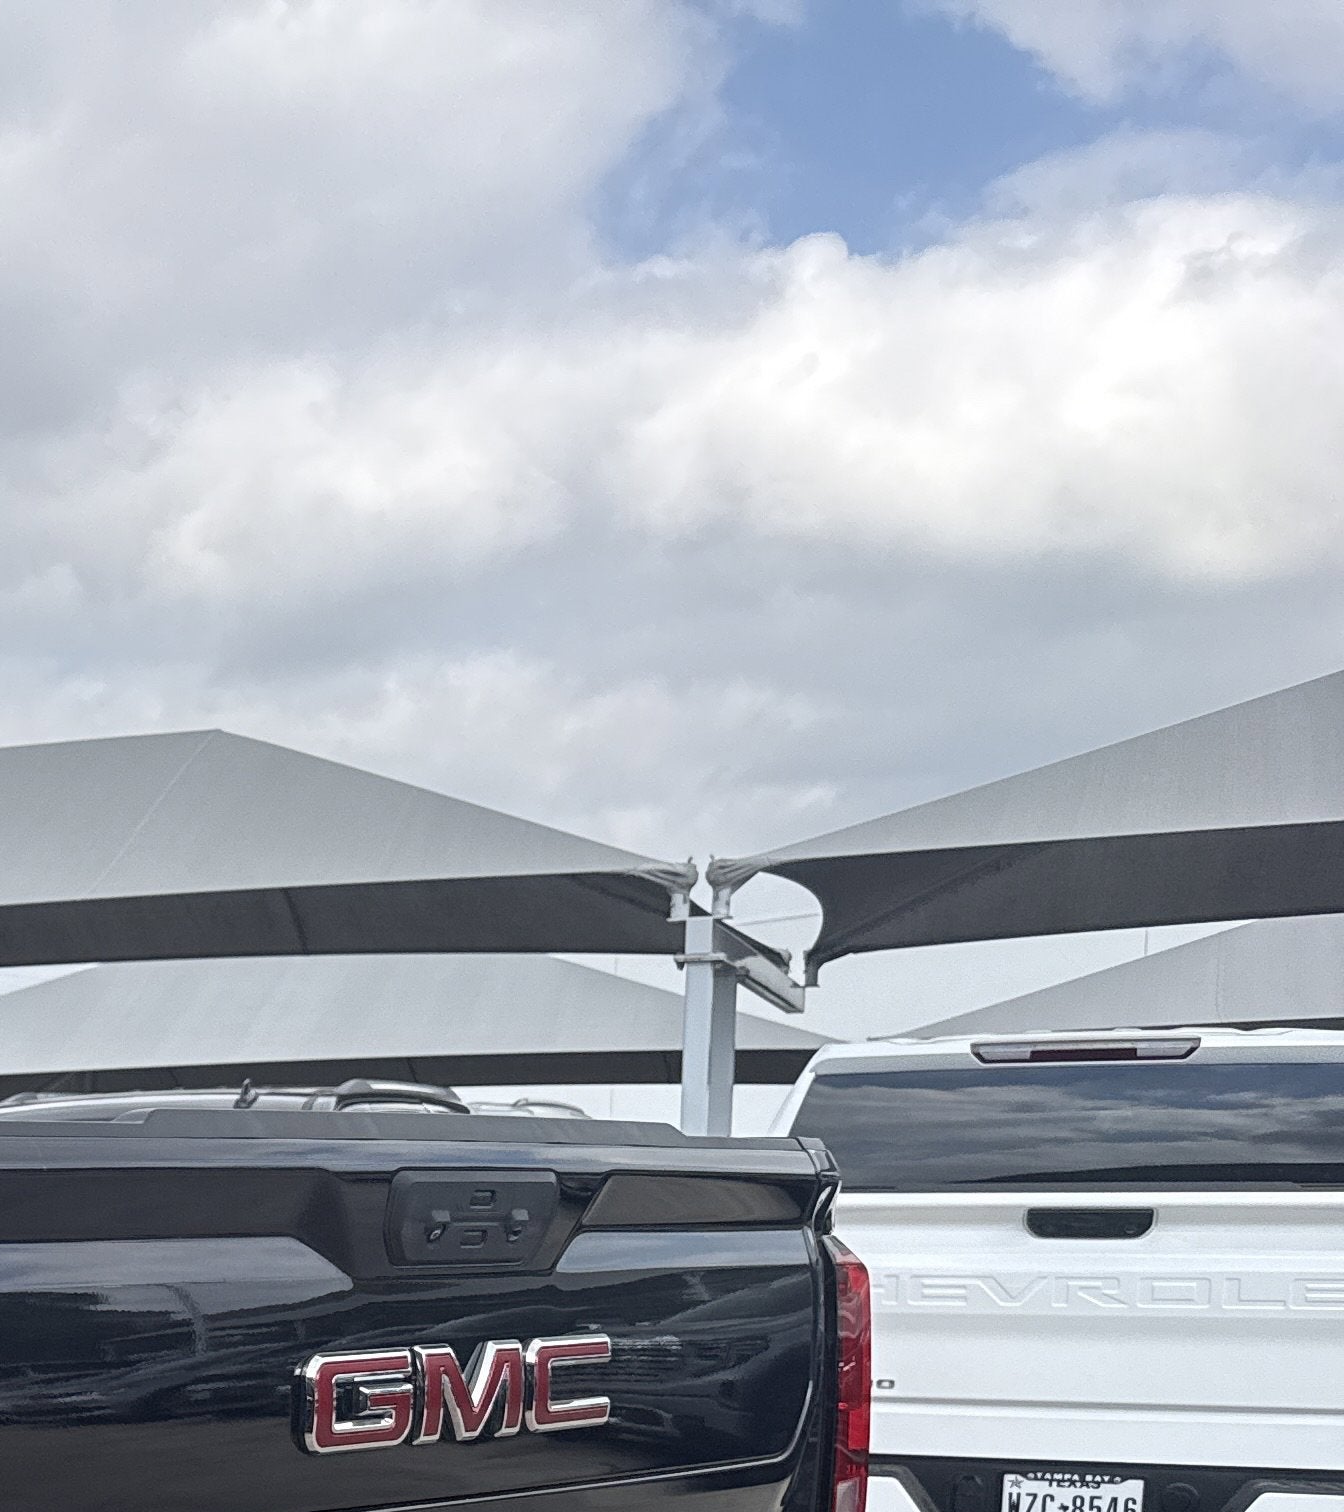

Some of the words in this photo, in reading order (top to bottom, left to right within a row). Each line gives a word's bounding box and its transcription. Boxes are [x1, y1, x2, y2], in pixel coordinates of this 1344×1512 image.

[872, 1273, 1344, 1310] EVROLE
[291, 1333, 612, 1455] GMC
[1036, 1471, 1080, 1482] TAMPA
[1084, 1473, 1111, 1483] BAY
